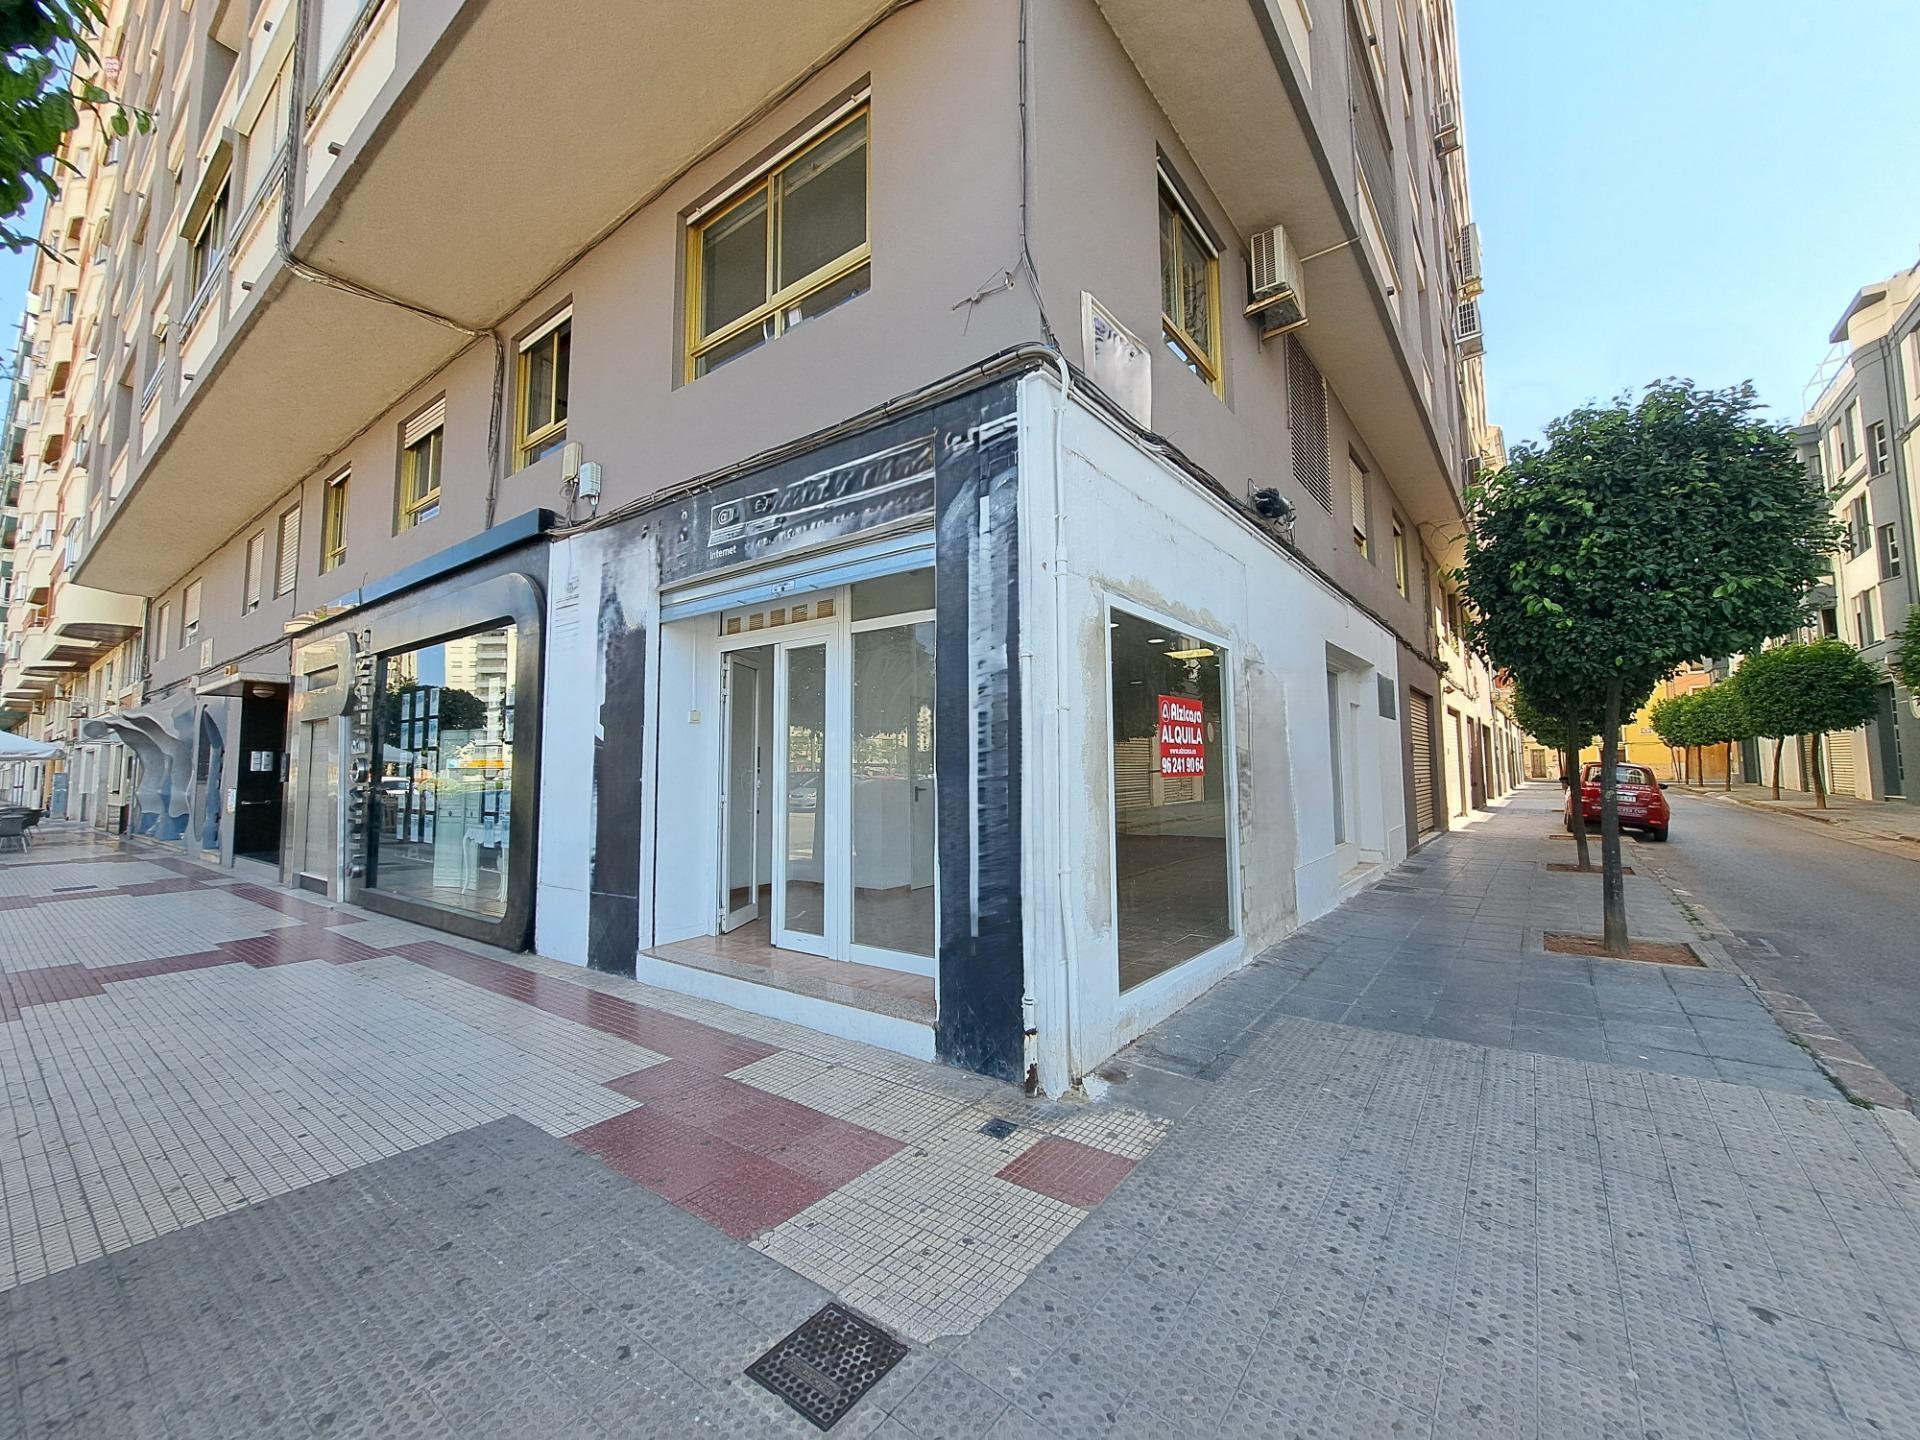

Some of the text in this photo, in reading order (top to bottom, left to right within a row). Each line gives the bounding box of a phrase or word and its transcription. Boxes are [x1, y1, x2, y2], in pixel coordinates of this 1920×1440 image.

[709, 545, 737, 560] Internet
[1161, 726, 1203, 744] ALQUILA
[1162, 758, 1171, 773] 96
[1172, 758, 1185, 773] 241
[1195, 758, 1204, 773] 64
